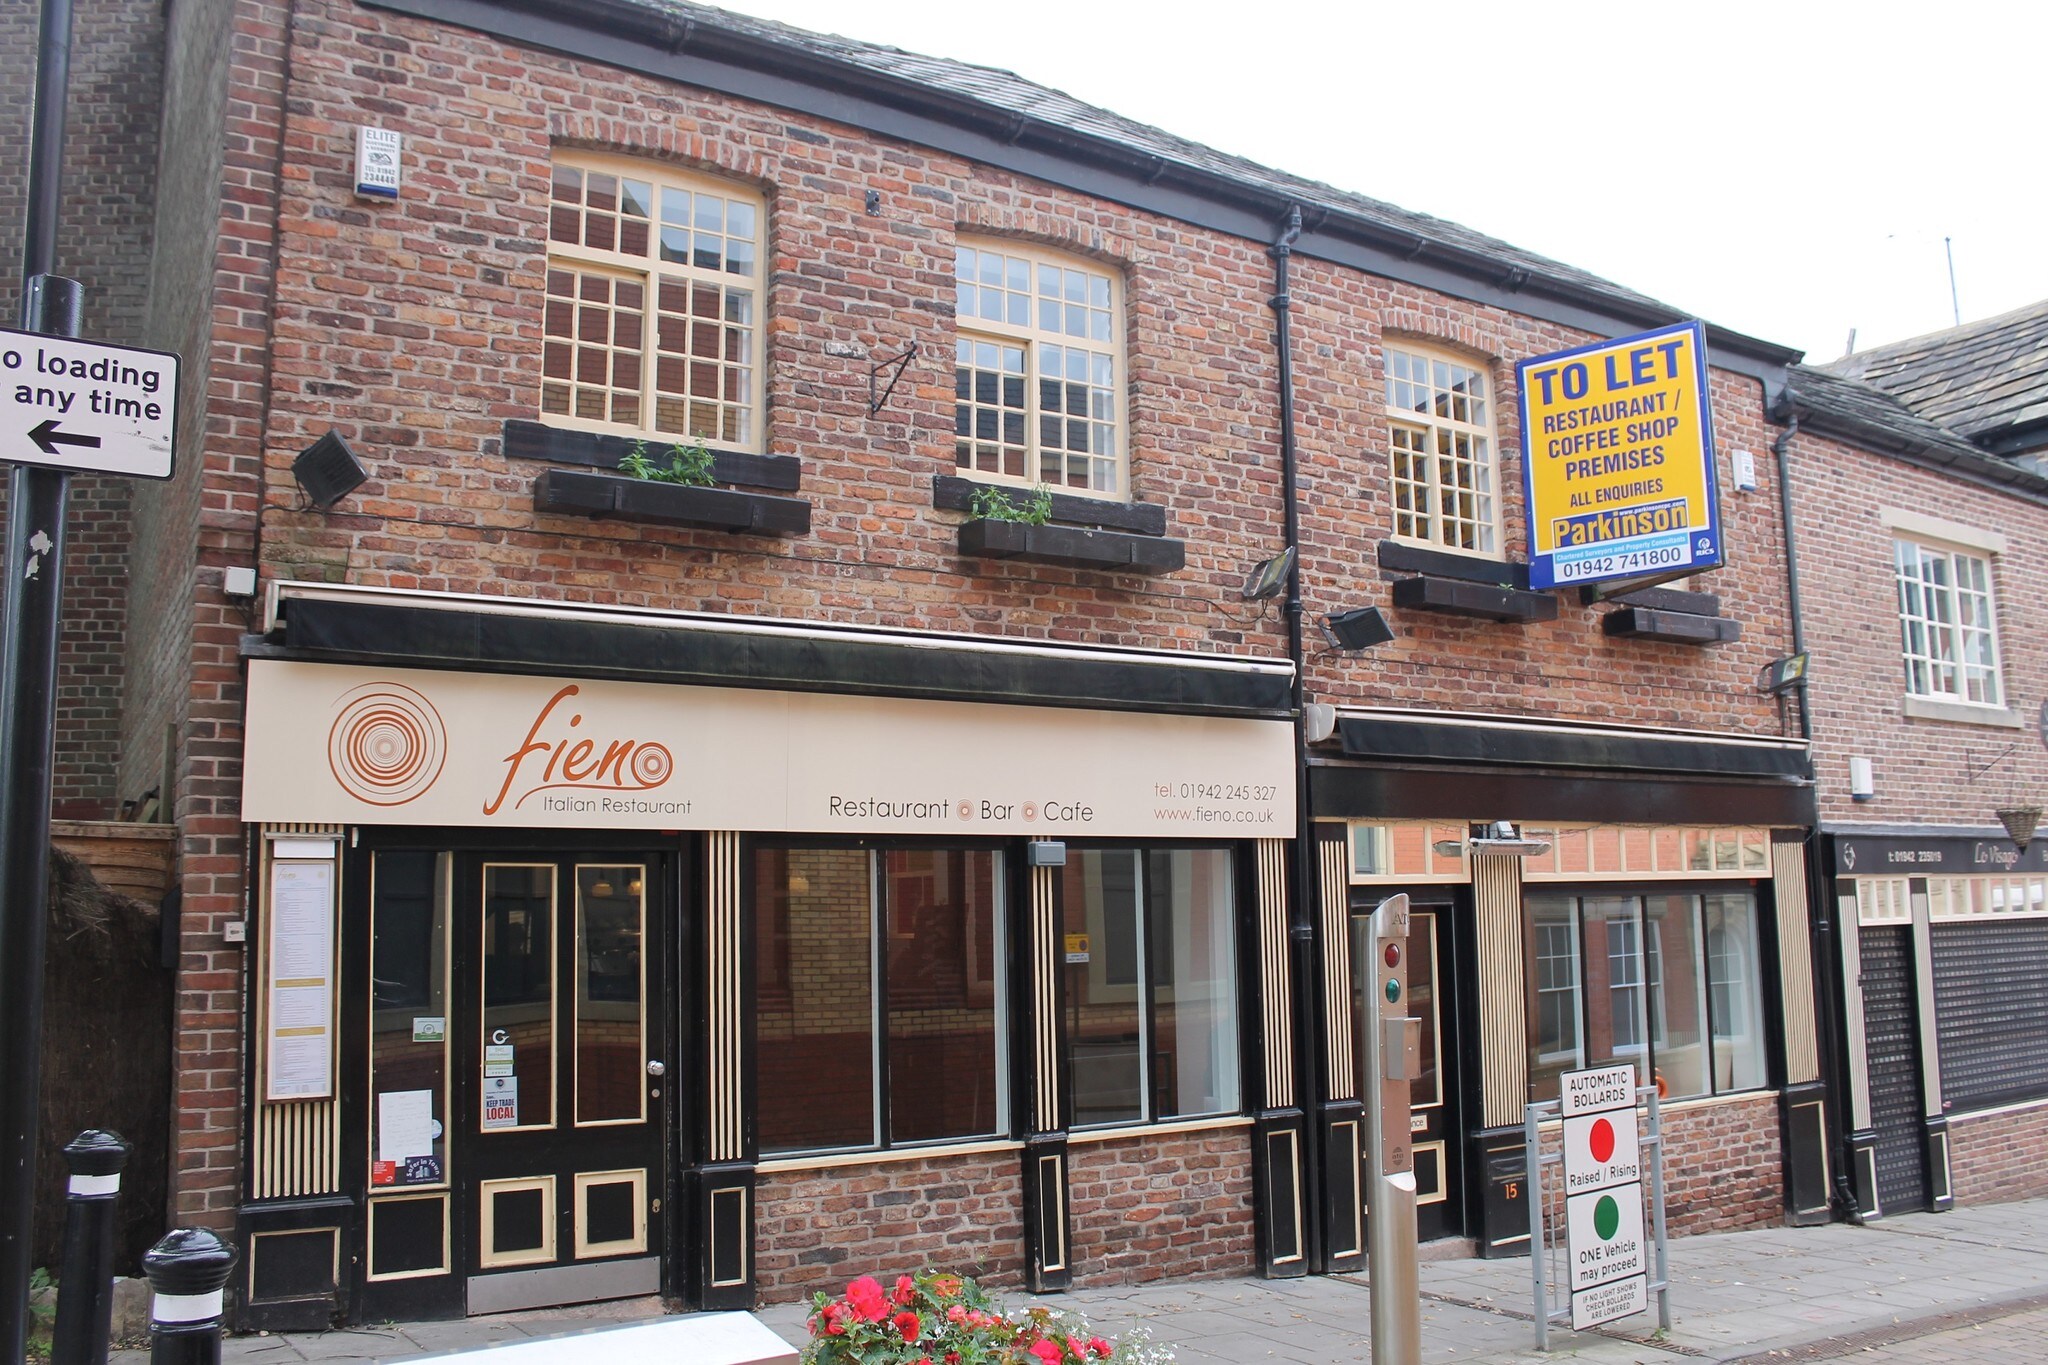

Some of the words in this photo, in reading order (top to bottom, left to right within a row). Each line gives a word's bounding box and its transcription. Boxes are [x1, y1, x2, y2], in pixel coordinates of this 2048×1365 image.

[366, 129, 396, 143] ELITE
[2, 350, 22, 369] o
[37, 349, 160, 393] loading
[1534, 362, 1589, 406] TO
[1605, 340, 1684, 392] LET
[15, 385, 76, 413] any
[89, 389, 161, 420] time
[1544, 391, 1667, 434] RESTAURANT
[1674, 388, 1681, 412] /
[1549, 427, 1619, 459] COFFEE
[1626, 416, 1679, 444] SHOP
[1565, 445, 1665, 481] PREMISES
[1570, 492, 1592, 508] ALL
[1596, 478, 1663, 503] ENQUIRIES
[1554, 505, 1687, 547] Parkinson
[1557, 551, 1584, 561] Chartered
[1585, 547, 1613, 559] Surveyors
[1613, 545, 1625, 553] and
[1626, 541, 1651, 553] Property
[1651, 536, 1686, 547] Consultants
[1563, 557, 1613, 577] 01942
[1619, 547, 1681, 570] 741800
[483, 684, 673, 816] fieno
[1154, 782, 1176, 798] tel.
[1180, 783, 1222, 799] 01942
[1226, 785, 1250, 800] 245
[1253, 785, 1277, 801] 327
[543, 796, 596, 812] Italian
[602, 797, 692, 814] Restaurant
[829, 795, 949, 819] Restaurant
[981, 800, 1014, 820] Bar
[1044, 801, 1094, 821] Cafe
[1153, 806, 1275, 823] www.fieno.co.uk
[1570, 1071, 1627, 1092] AUTOMATIC
[499, 1099, 515, 1107] TRADE
[1574, 1088, 1626, 1108] BOLLARDS
[486, 1107, 515, 1120] LOCAL
[428, 1159, 440, 1175] Town
[1570, 1169, 1600, 1187] Raised
[1610, 1164, 1637, 1179] Rising
[1505, 1183, 1518, 1199] 15
[1579, 1247, 1601, 1264] ONE
[1604, 1240, 1636, 1258] Vehicle
[1580, 1268, 1599, 1281] may
[1602, 1255, 1637, 1278] proceed
[1583, 1295, 1588, 1303] IF
[1590, 1293, 1599, 1302] NO
[1600, 1287, 1615, 1299] LIGHT
[1616, 1282, 1637, 1294] SHOWS
[1585, 1301, 1605, 1312] CHECK
[1606, 1291, 1634, 1306] BOLLARDS
[1591, 1310, 1602, 1319] ARE
[1603, 1302, 1631, 1316] LOWERED
